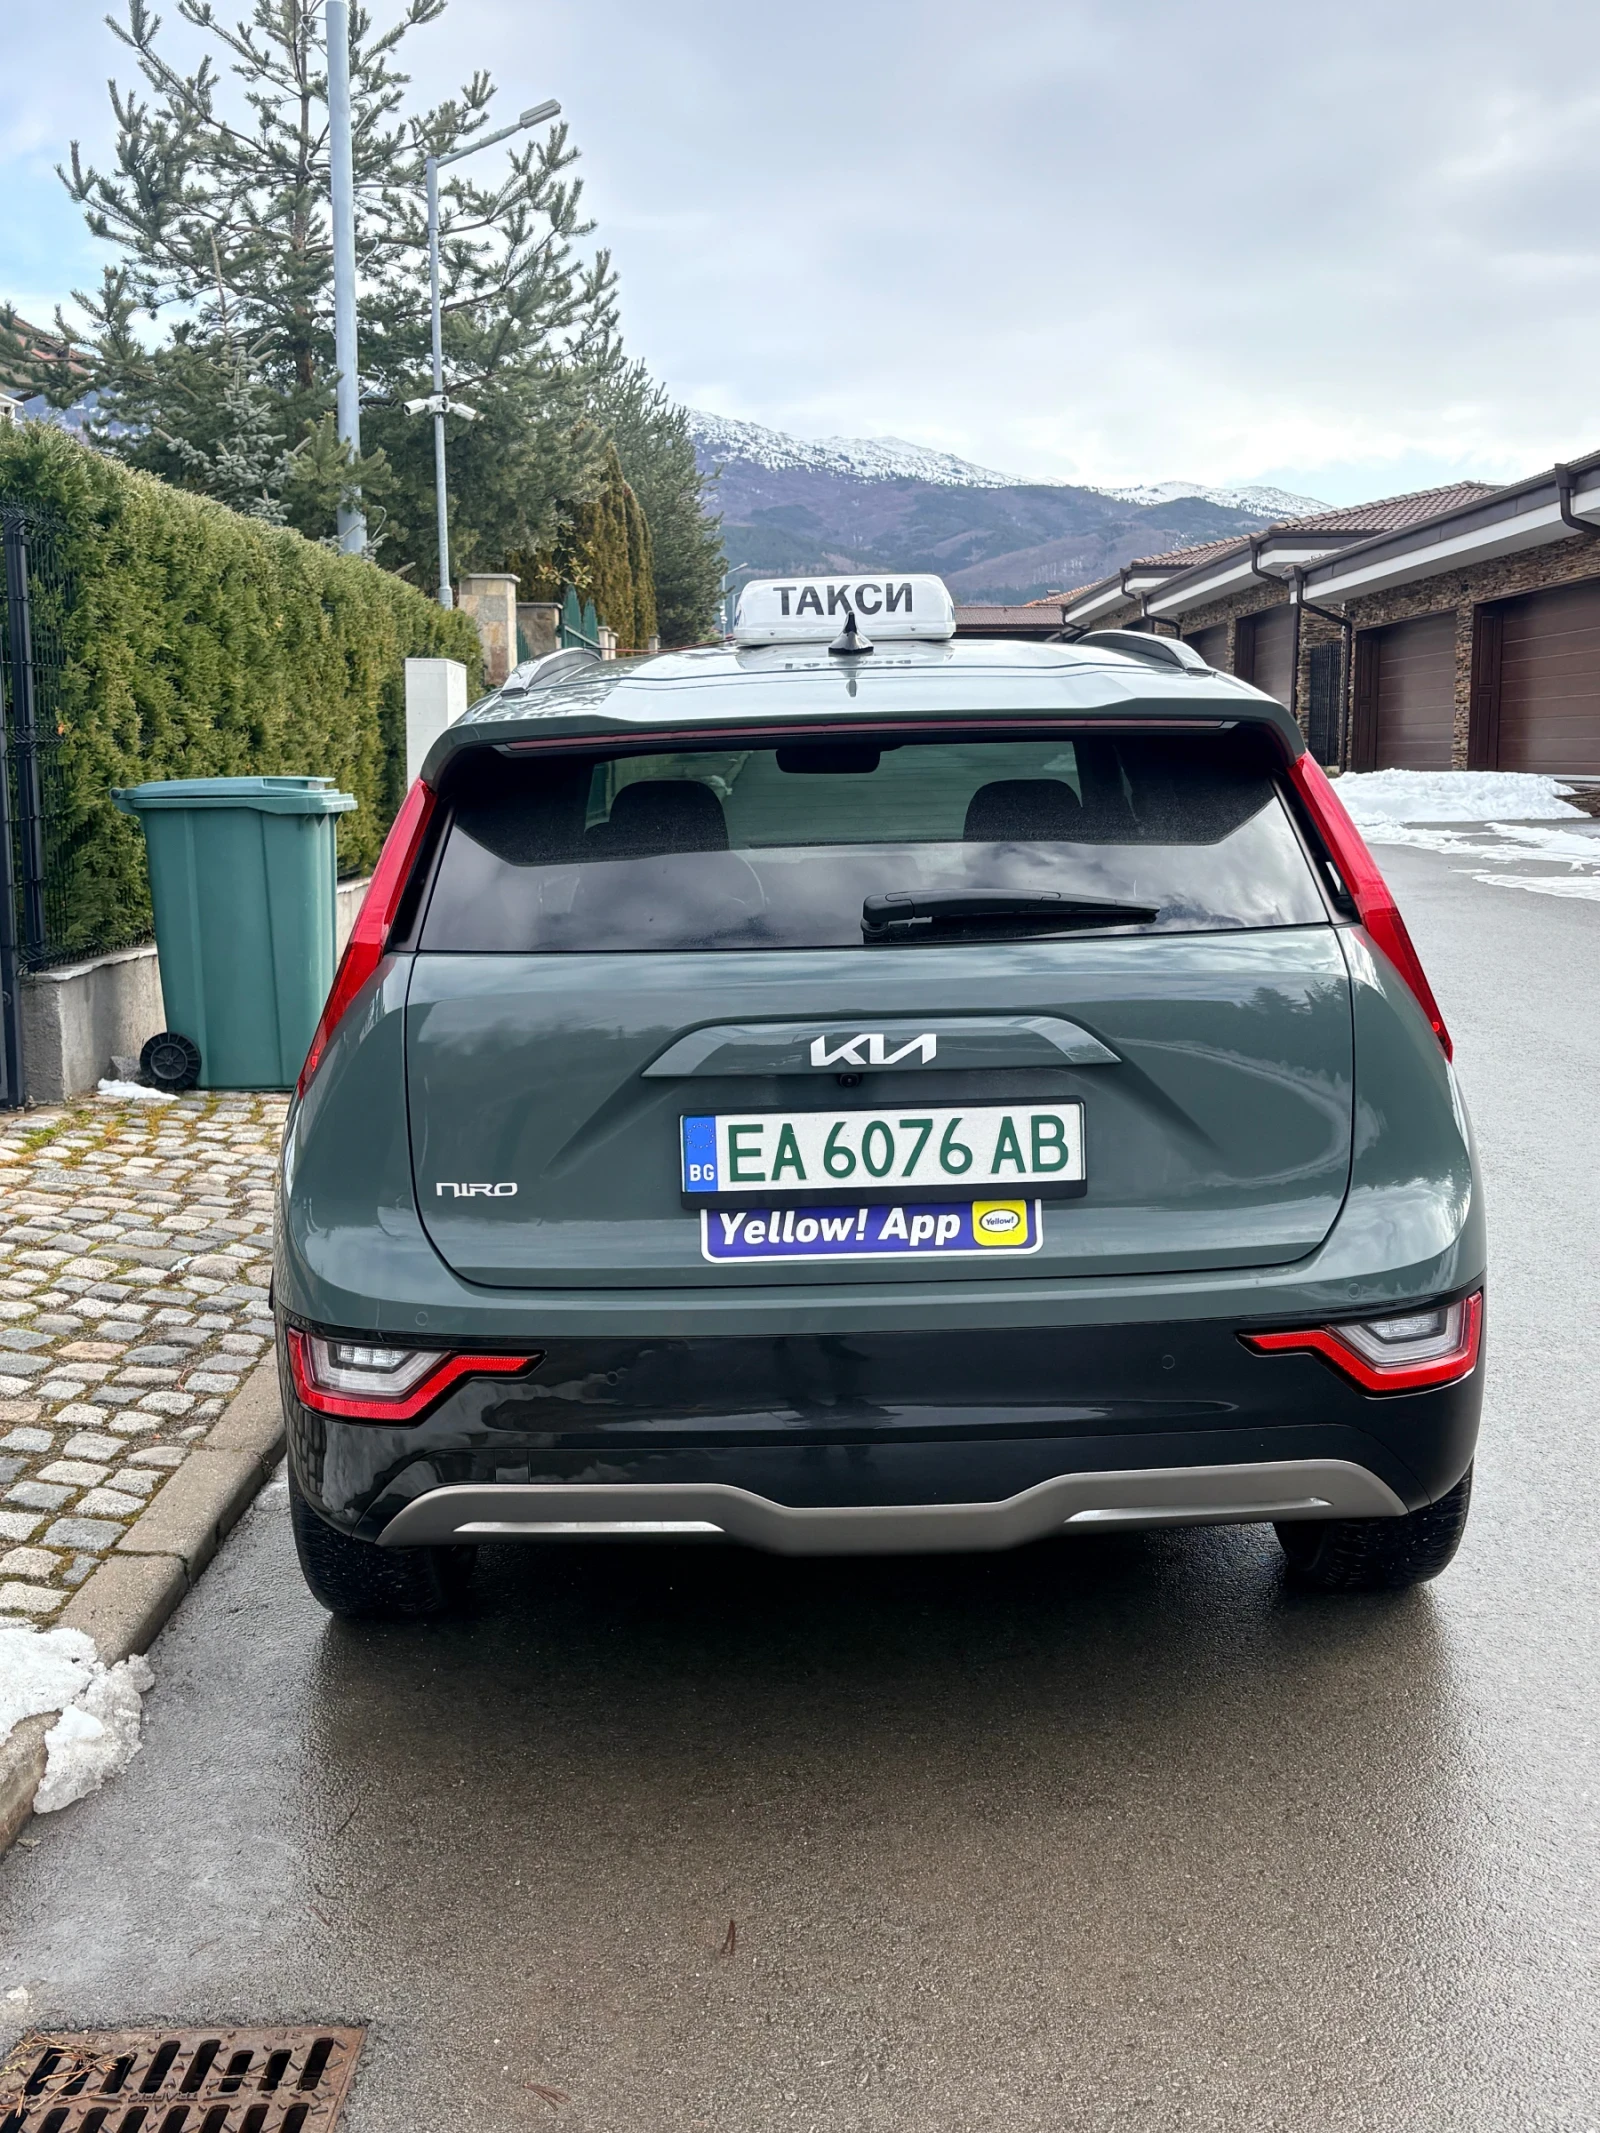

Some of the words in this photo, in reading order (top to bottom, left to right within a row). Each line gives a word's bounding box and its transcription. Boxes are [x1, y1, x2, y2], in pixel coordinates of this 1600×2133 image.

[773, 582, 913, 616] ТАКСИ
[810, 1033, 937, 1067] KIA
[728, 1123, 807, 1182] EA
[823, 1117, 973, 1179] 6076
[990, 1114, 1069, 1174] AB
[689, 1163, 715, 1182] BG
[719, 1207, 869, 1245] Yellow!
[877, 1206, 961, 1247] App
[985, 1215, 1015, 1226] Yellow!
